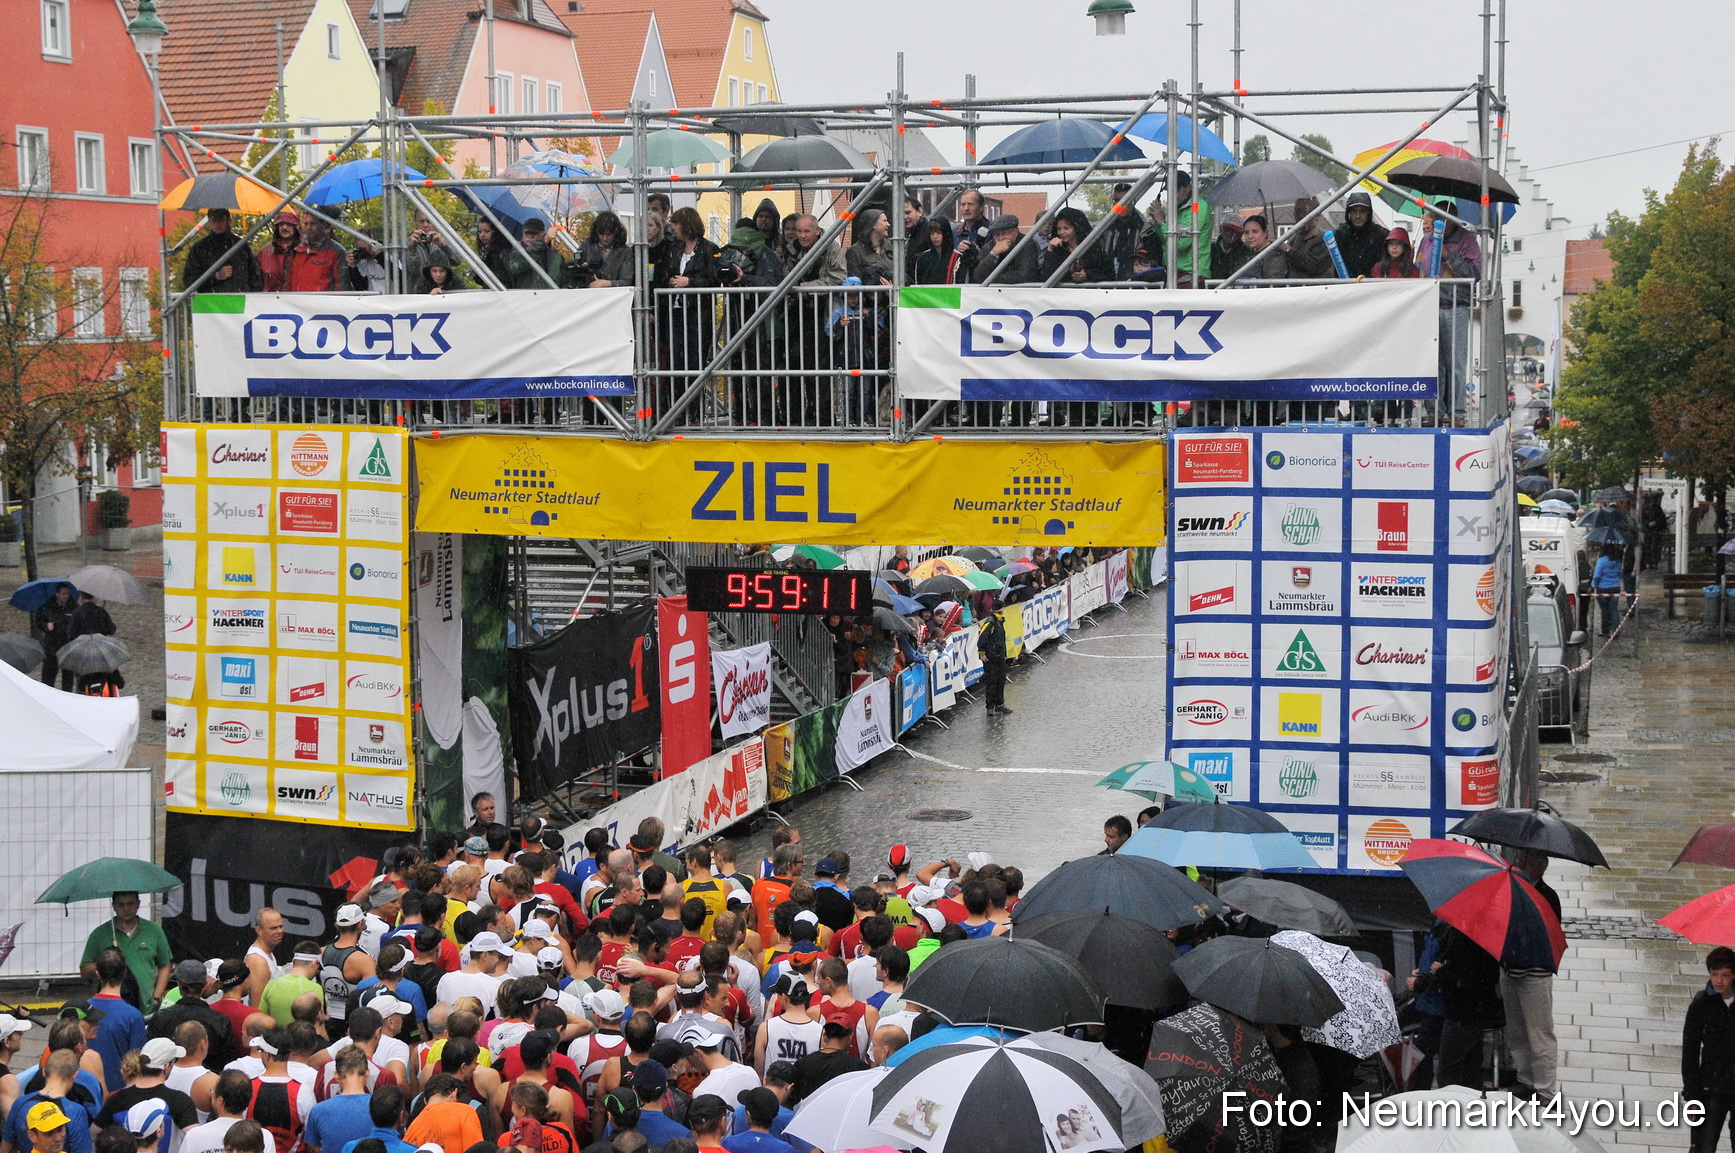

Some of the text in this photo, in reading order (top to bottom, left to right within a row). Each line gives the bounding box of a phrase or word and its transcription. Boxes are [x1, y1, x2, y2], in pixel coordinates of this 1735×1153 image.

[244, 313, 451, 360] BOCK
[960, 308, 1224, 360] BOCK
[525, 378, 625, 392] www.bockonline.de
[1310, 380, 1427, 394] www.bockonline.de
[211, 443, 267, 463] Charivari
[1185, 442, 1242, 452] GUT FÜR SIE!
[291, 453, 329, 461] WITTMANN
[1289, 456, 1337, 467] Bionorica
[1193, 461, 1218, 469] Sparkasse
[1193, 468, 1243, 477] Neumarkt-Parsberg
[450, 487, 601, 506] Neumarkter Stadtlauf
[691, 460, 857, 523] ZIEL
[286, 495, 332, 506] GUT FÜR SIE!
[953, 498, 1122, 512] Neumarkter Stadtlauf
[213, 501, 264, 520] Xplus1
[1283, 503, 1318, 526] RUND
[1177, 516, 1225, 532] swn
[1281, 523, 1322, 546] SCHAU
[1378, 528, 1406, 542] Braun
[224, 573, 252, 583] KANN
[305, 568, 336, 576] ReiseCenter
[367, 568, 398, 580] Bionorica
[1368, 576, 1426, 585] INTERSPORT
[727, 574, 856, 610] 9:59:11
[1278, 592, 1326, 600] Neumarkter
[1360, 585, 1426, 597] HACKNER
[1201, 594, 1222, 604] DEHN
[1269, 601, 1334, 612] Lammsbräu
[220, 610, 264, 618] INTERSPORT
[213, 618, 264, 628] HACKNER
[298, 626, 336, 636] MAX BÖGL
[1224, 650, 1249, 659] BÖGL
[1355, 642, 1428, 666] Charivari
[225, 662, 252, 677] maxi
[240, 685, 252, 695] dsl
[299, 687, 316, 697] DEHN
[526, 635, 651, 768] Xplus1
[1176, 706, 1218, 714] GERHART
[1194, 712, 1224, 720] JANIG
[209, 725, 243, 733] GERHART
[1282, 722, 1318, 733] KANN
[225, 732, 247, 740] JANIG
[295, 740, 317, 752] Braun
[358, 745, 395, 755] Neumarkter
[351, 753, 402, 766] Lammsbräu
[1193, 756, 1228, 775] maxi
[1282, 756, 1315, 778] RUND
[1380, 771, 1393, 783] §§
[278, 786, 315, 799] swn
[1280, 776, 1320, 798] SCHAU
[1353, 782, 1383, 790] Mümmler
[1410, 782, 1426, 791] Kölbl
[348, 791, 403, 807] NATHUS
[1304, 834, 1331, 844] Tagblatt
[1148, 1051, 1222, 1075] LONDON
[1160, 1076, 1200, 1105] ayfair
